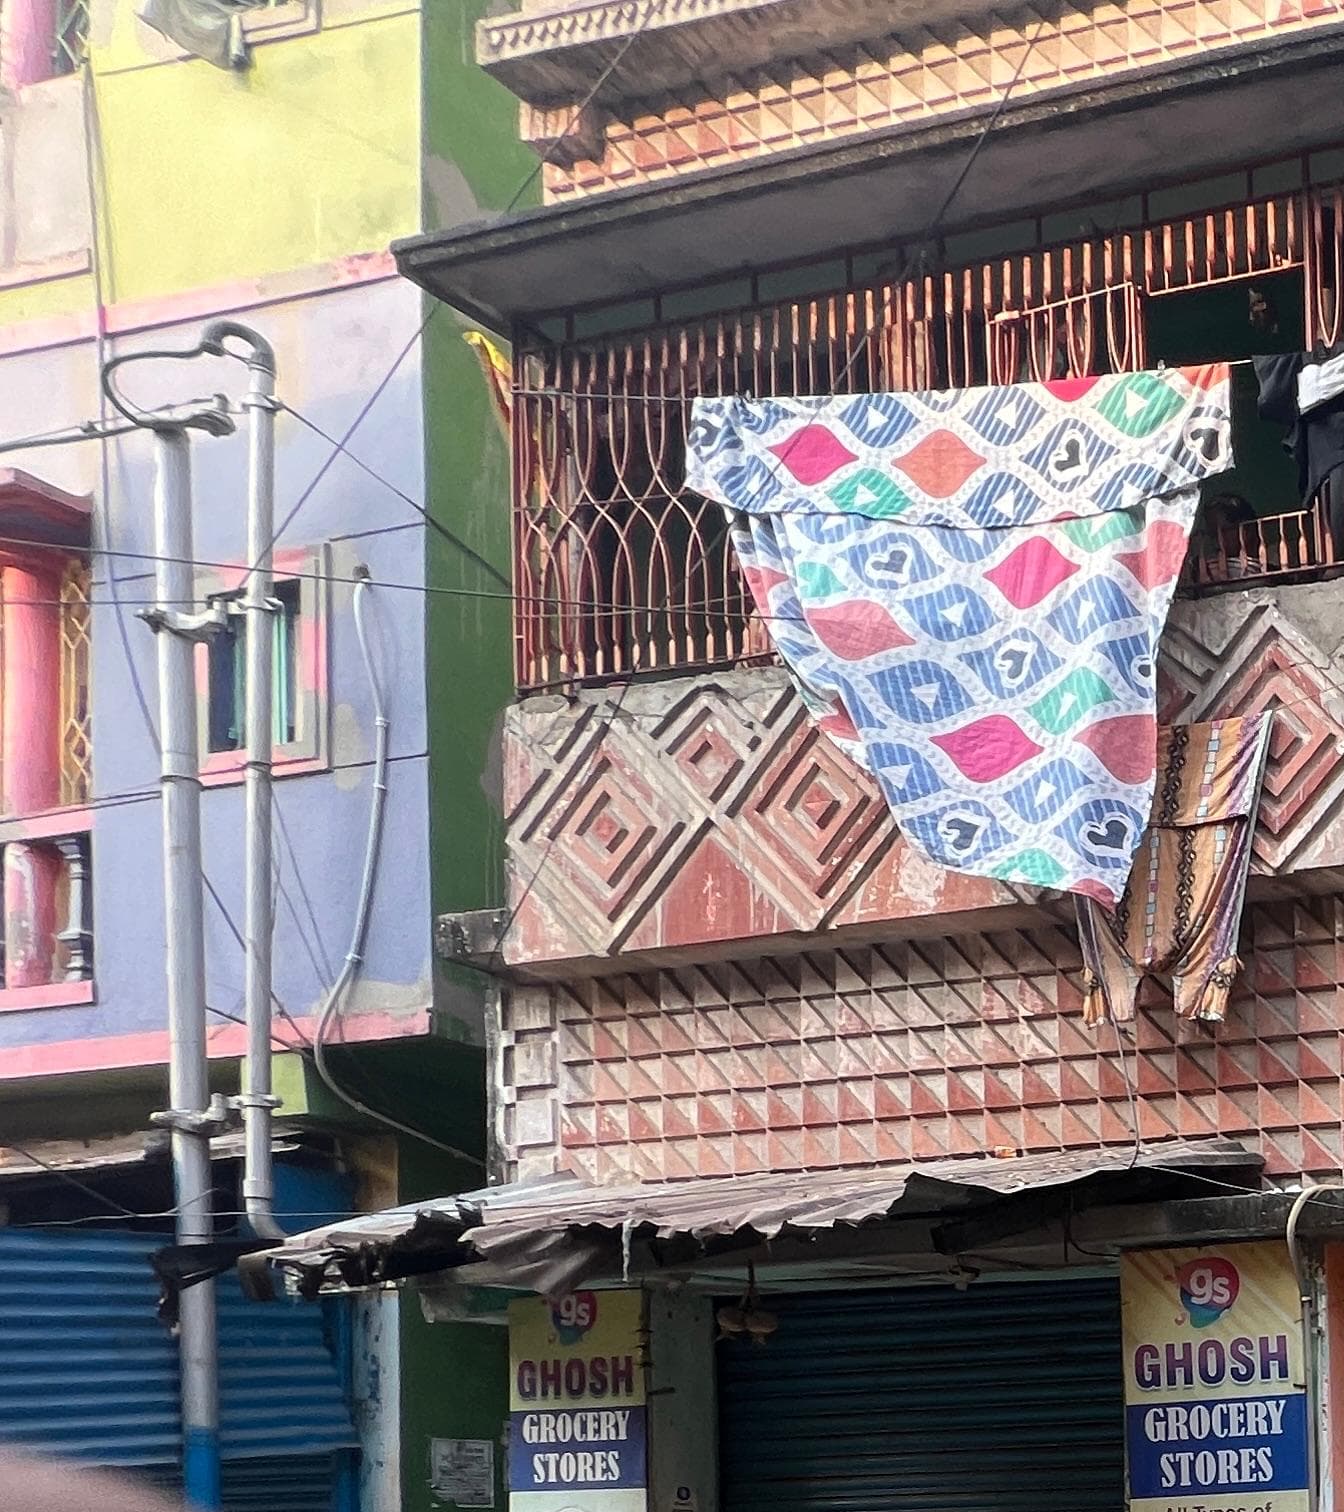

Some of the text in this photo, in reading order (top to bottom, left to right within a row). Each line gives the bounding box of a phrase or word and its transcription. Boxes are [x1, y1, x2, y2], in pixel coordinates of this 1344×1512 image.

[1190, 1268, 1230, 1304] gs
[517, 1355, 634, 1400] GHOSH
[1134, 1335, 1289, 1389] GHOSH
[522, 1411, 630, 1444] GROCERY
[1144, 1400, 1286, 1442] GROCERY
[533, 1451, 620, 1483] STORES
[1160, 1447, 1273, 1487] STORES
